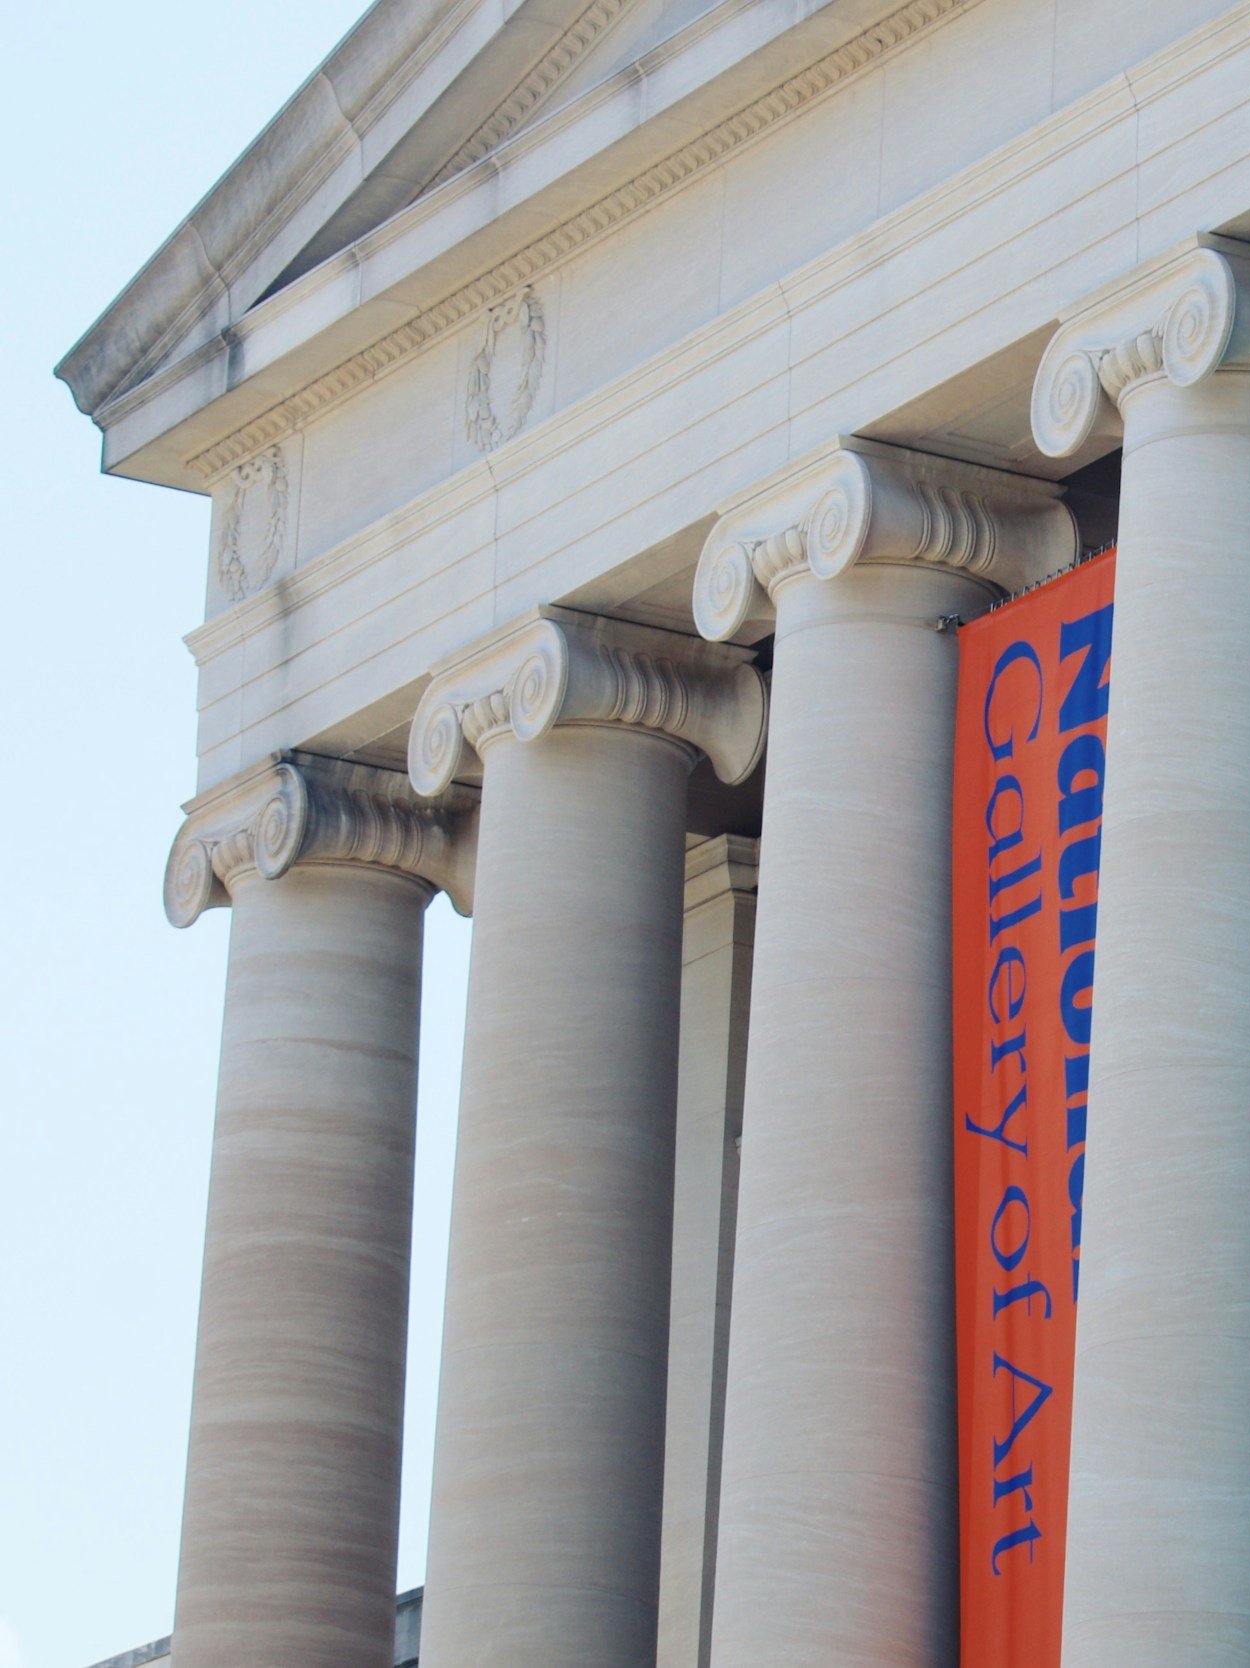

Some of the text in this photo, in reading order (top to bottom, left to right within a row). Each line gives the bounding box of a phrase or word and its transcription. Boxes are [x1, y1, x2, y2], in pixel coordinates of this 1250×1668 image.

[966, 640, 1054, 1576] Gallery of Art
